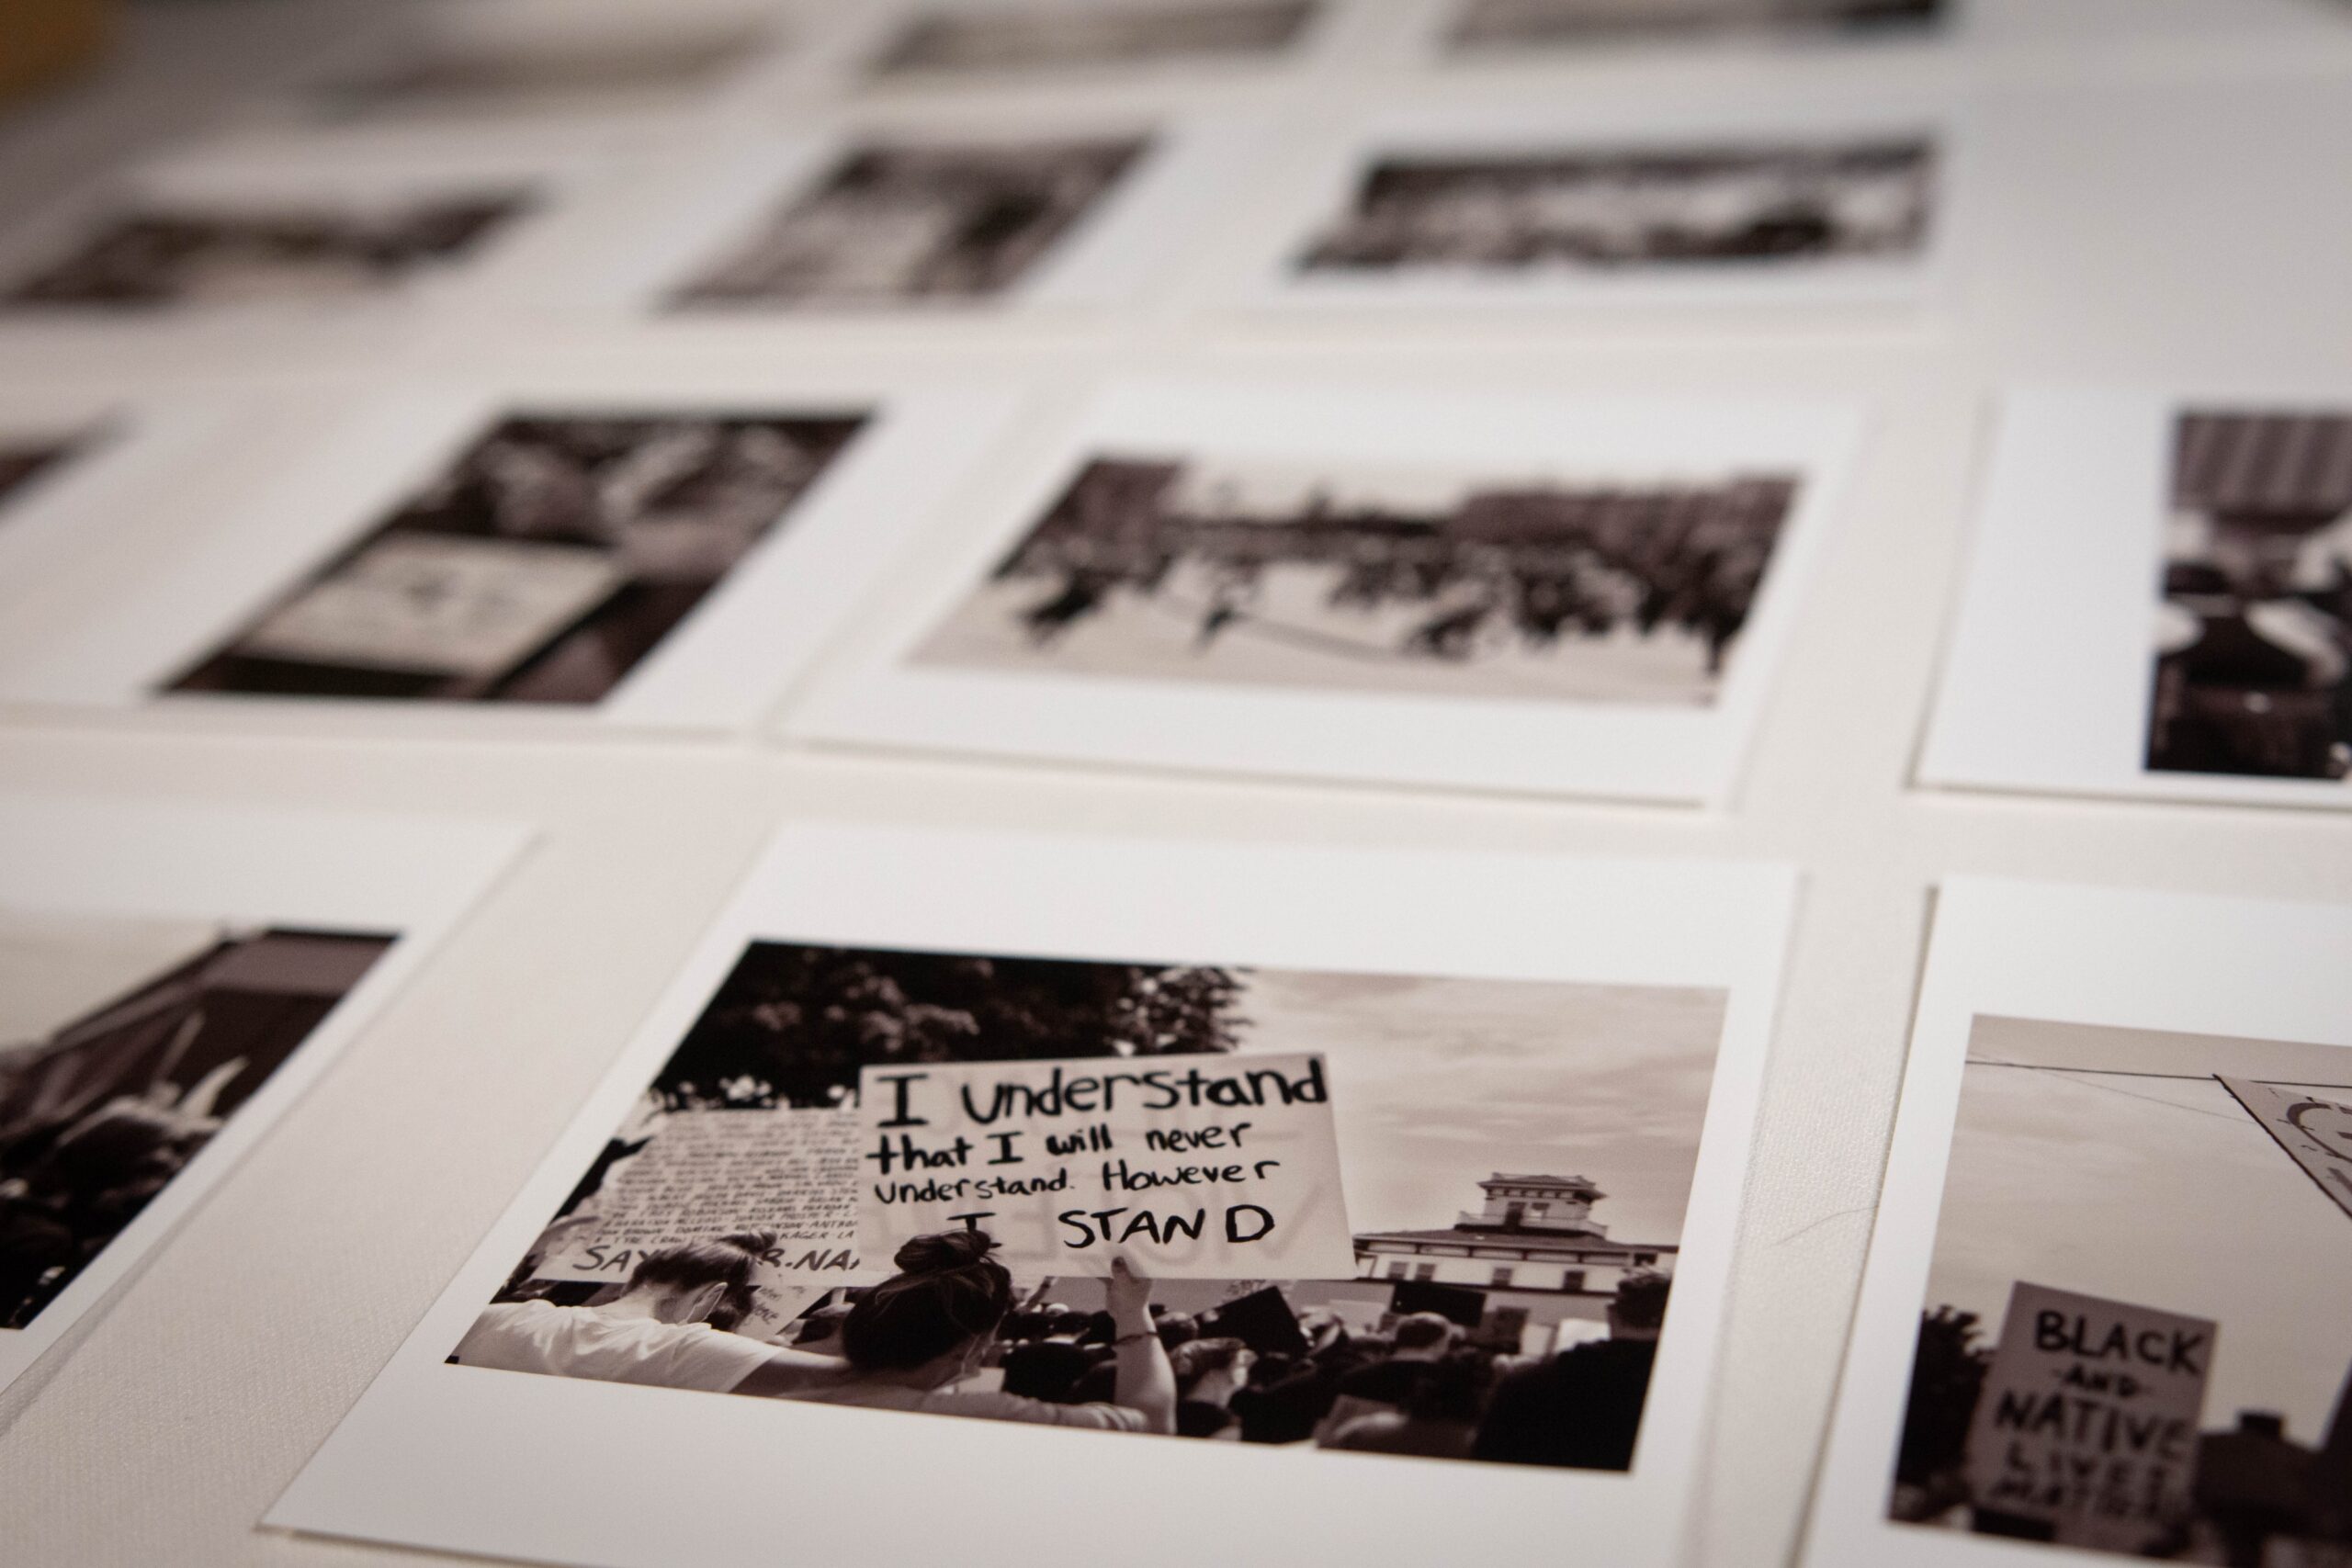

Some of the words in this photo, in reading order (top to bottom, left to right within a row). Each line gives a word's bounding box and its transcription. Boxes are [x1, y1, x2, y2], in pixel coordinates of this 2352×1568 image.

[875, 1073, 930, 1129] I
[960, 1057, 1329, 1124] Understand
[865, 1133, 975, 1176] that
[987, 1130, 1024, 1166] I
[1046, 1123, 1113, 1157] will
[1146, 1120, 1253, 1154] never
[1102, 1157, 1282, 1193] However
[1057, 1203, 1276, 1249] STAND
[2035, 1311, 2205, 1375] BLACK
[1996, 1389, 2189, 1462] NATIVE
